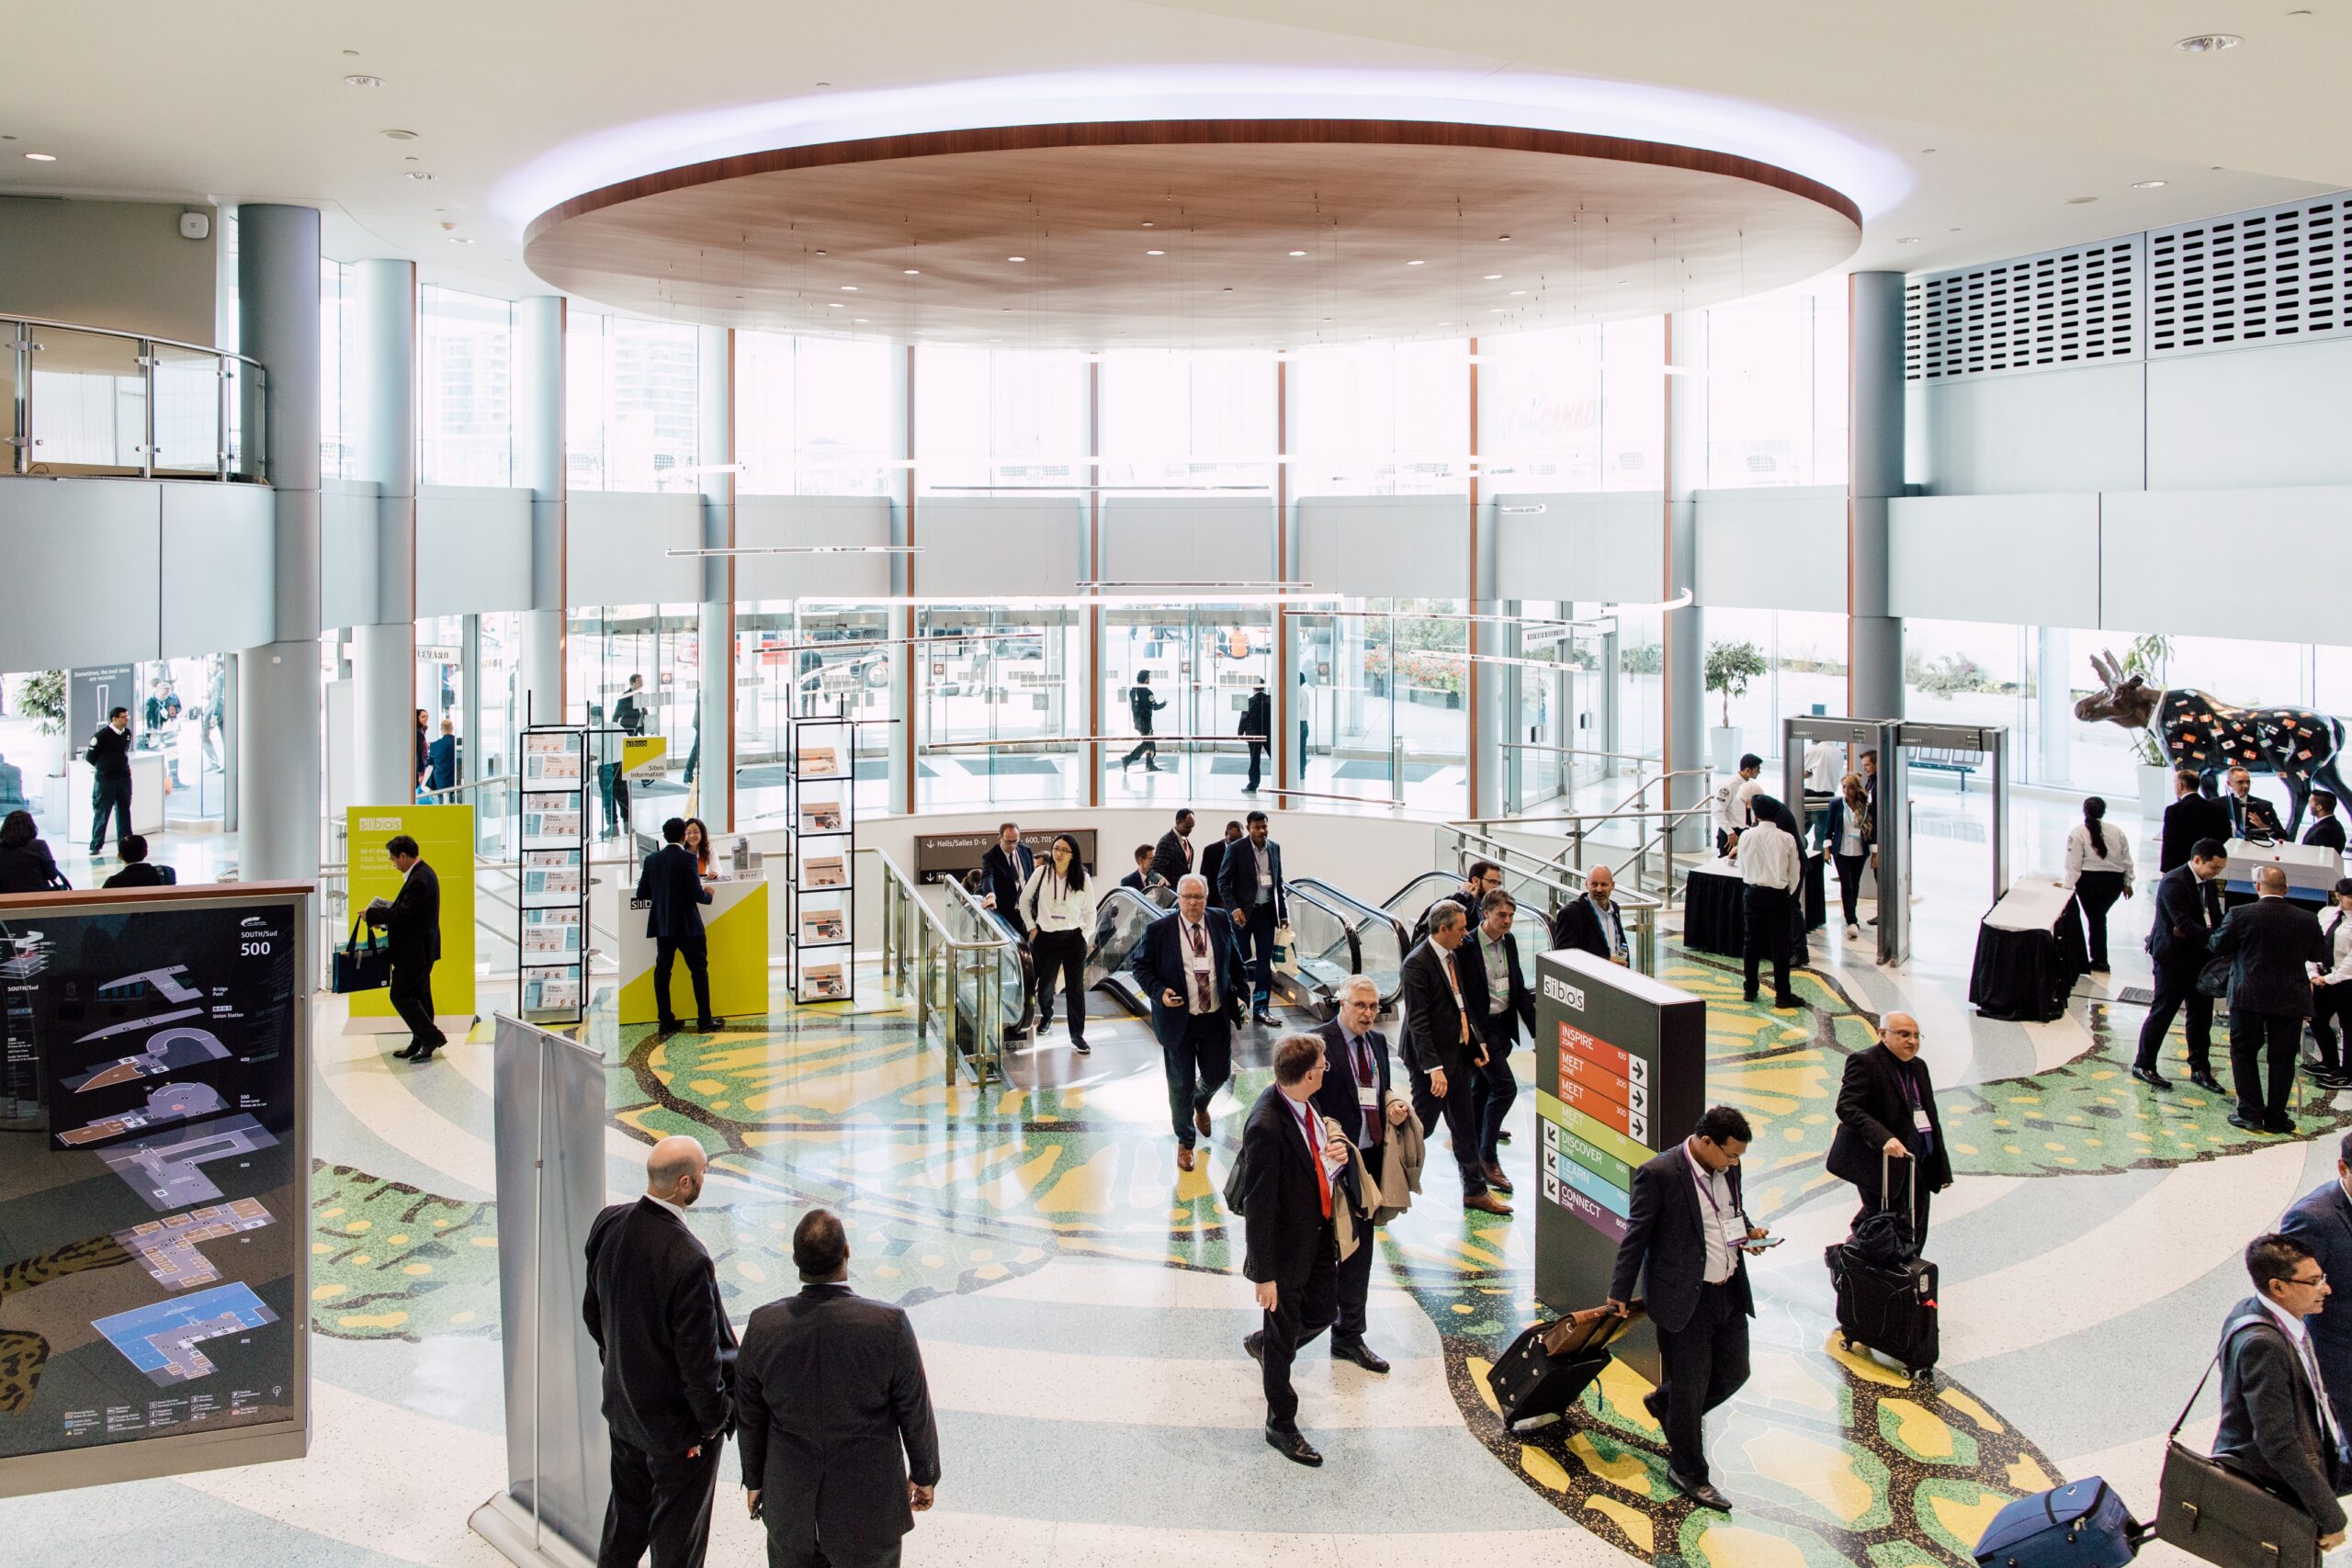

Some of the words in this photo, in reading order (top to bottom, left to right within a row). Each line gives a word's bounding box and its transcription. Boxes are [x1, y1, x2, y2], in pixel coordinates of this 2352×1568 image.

[417, 649, 449, 660] LEVARD
[359, 818, 401, 830] sibos
[937, 839, 973, 848] Halls/Salles
[974, 838, 988, 846] D-G
[1025, 836, 1040, 844] 600,
[631, 899, 652, 909] sib
[241, 931, 277, 939] SOUTH/Sud
[241, 942, 270, 955] 500
[1545, 980, 1583, 1009] sibos
[1562, 1025, 1594, 1050] INSPIRE
[1562, 1038, 1575, 1049] ZONE
[1562, 1052, 1584, 1072] MEET
[1617, 1051, 1627, 1061] 100
[1562, 1065, 1575, 1076] ZONE
[1562, 1078, 1584, 1099] MEET
[1617, 1078, 1627, 1089] 200
[1562, 1090, 1575, 1102] ZONE
[1562, 1105, 1584, 1125] MEET
[1617, 1106, 1627, 1117] 300
[1562, 1132, 1602, 1165] DISCOVER
[1562, 1145, 1574, 1156] ZONE
[1562, 1158, 1589, 1185] LEARN
[1616, 1163, 1627, 1174] 600
[1562, 1186, 1600, 1218] CONNECT
[1562, 1198, 1575, 1211] ZONE
[1616, 1218, 1627, 1230] 800
